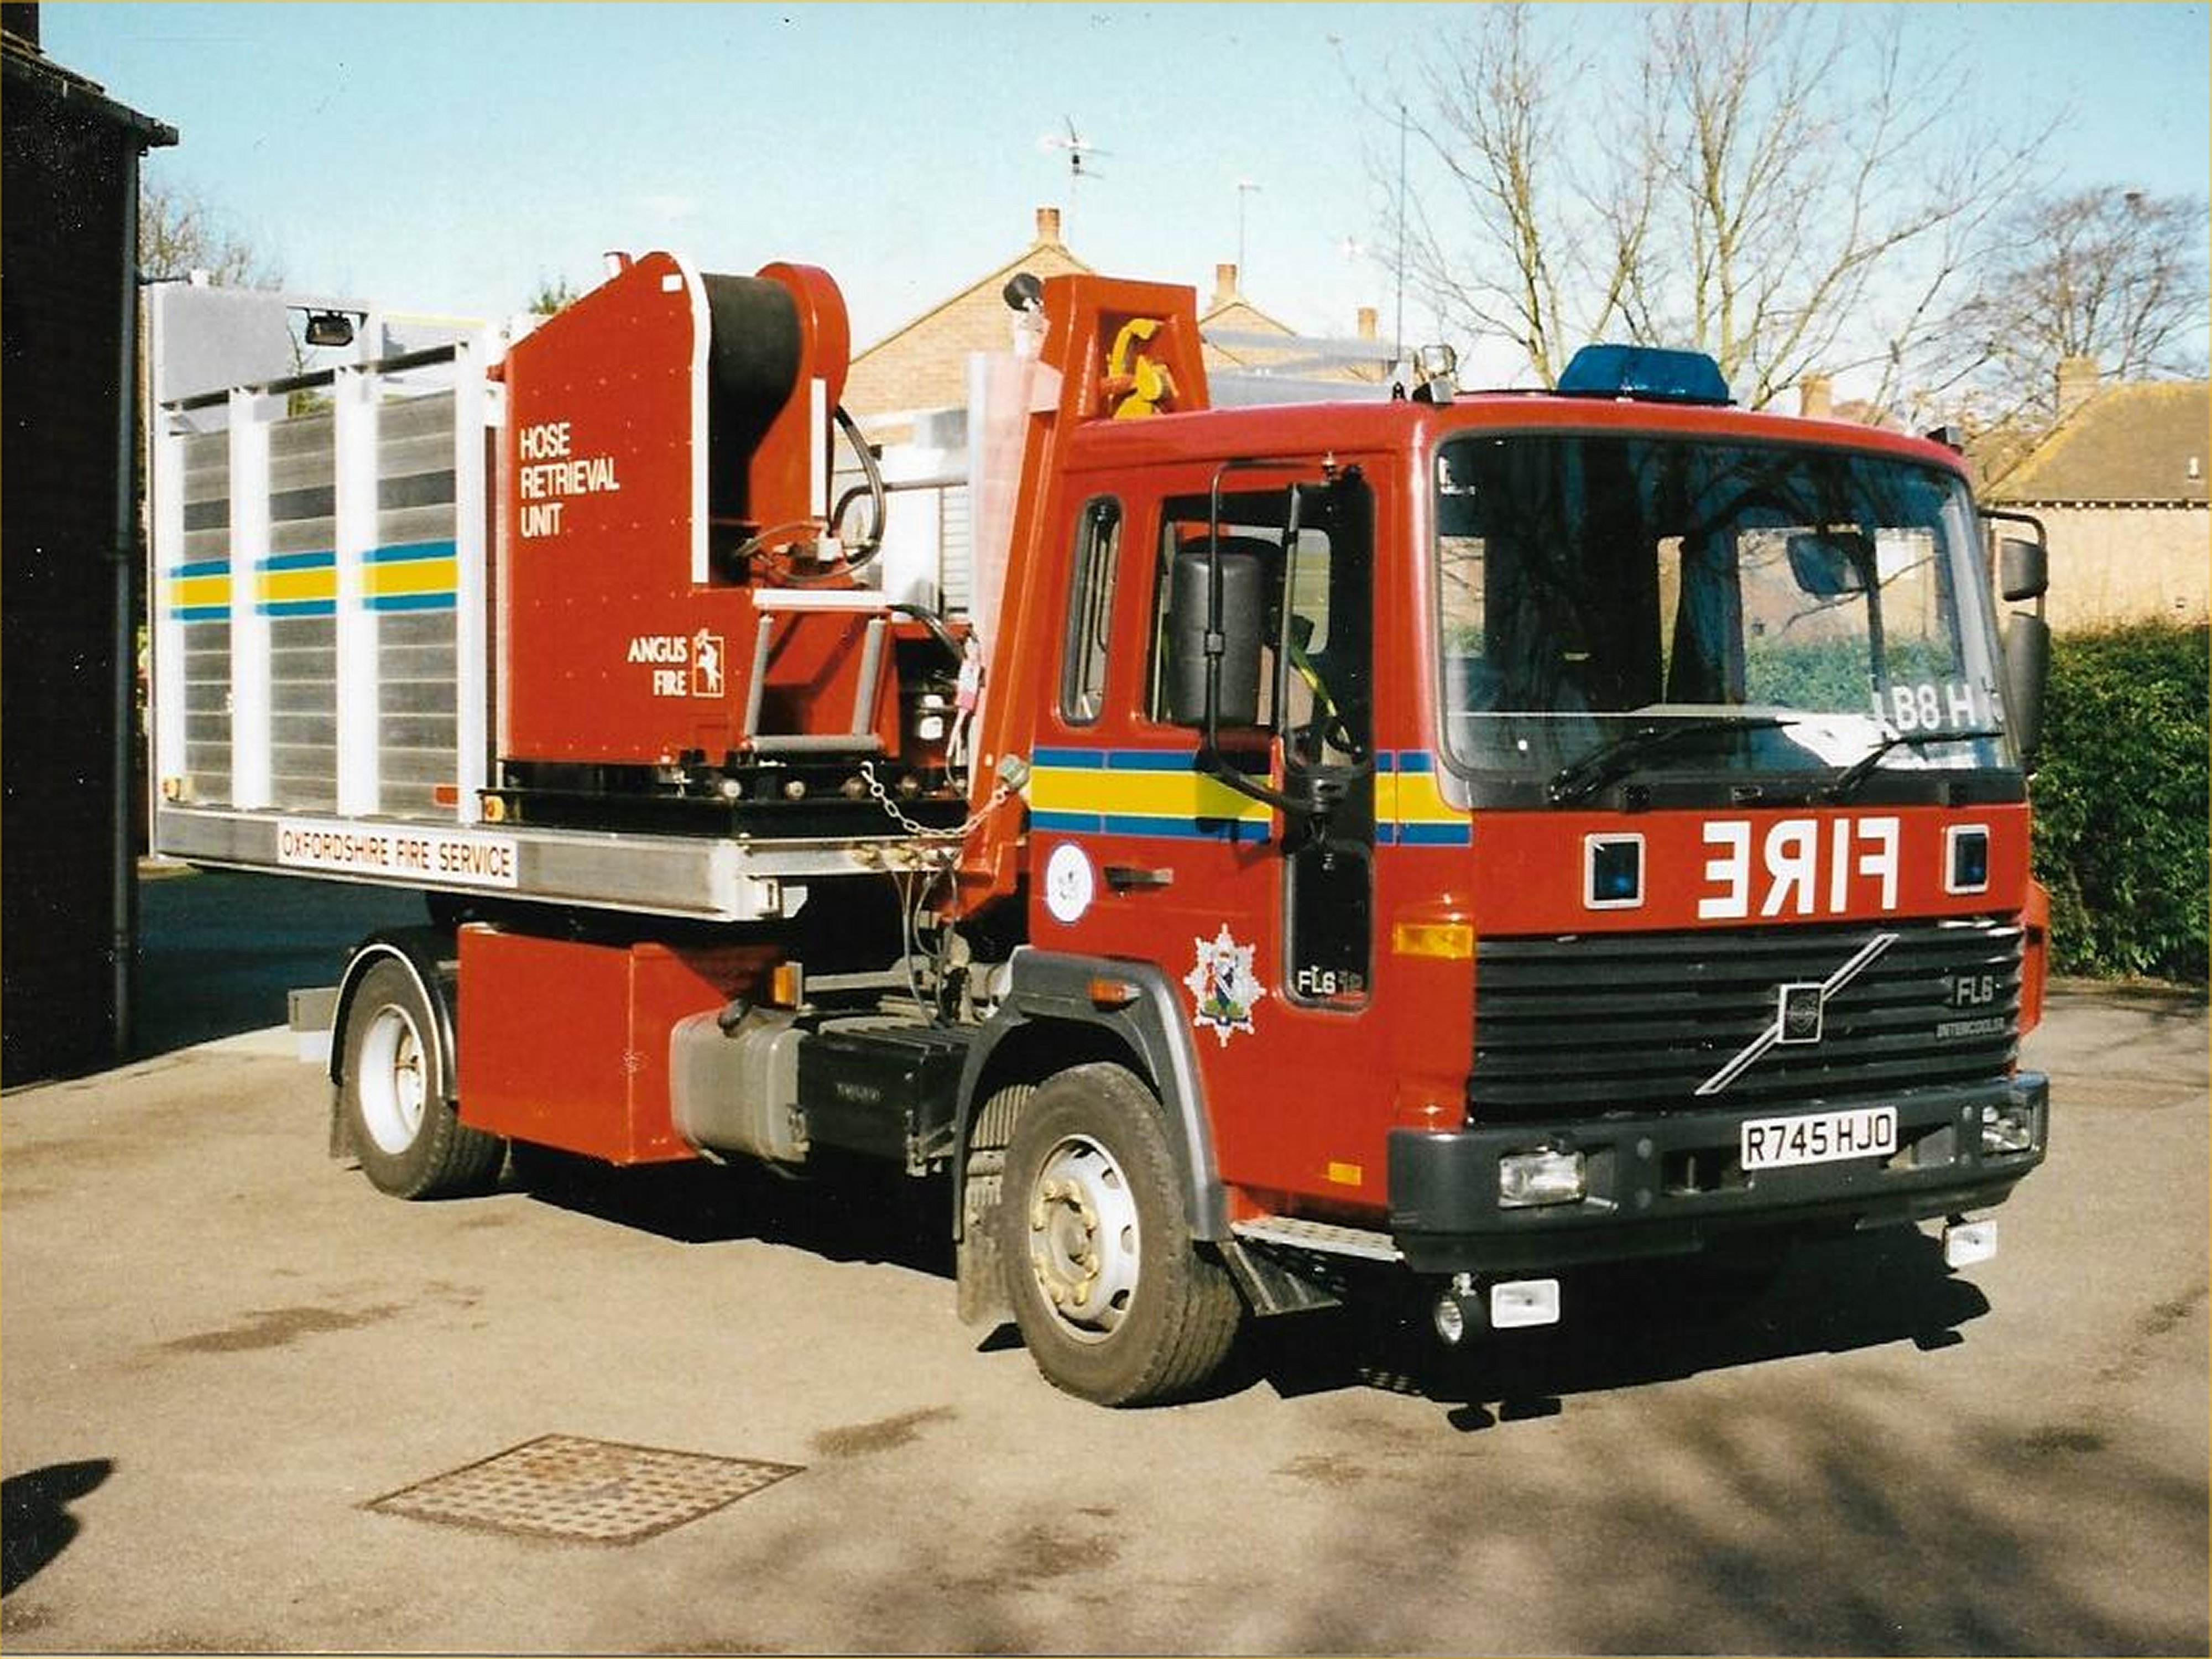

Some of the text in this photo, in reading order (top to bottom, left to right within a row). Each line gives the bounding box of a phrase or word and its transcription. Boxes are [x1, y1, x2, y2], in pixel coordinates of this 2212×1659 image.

[520, 422, 571, 460] HOSE
[520, 457, 620, 499] RETRIEVAL
[520, 502, 564, 538] UNIT
[627, 637, 687, 663] ANGUS
[653, 670, 687, 696] FIRE
[283, 830, 511, 878] OXFORDSHIRE FIRE SERVICE
[1747, 1114, 1891, 1163] R745 HJO
